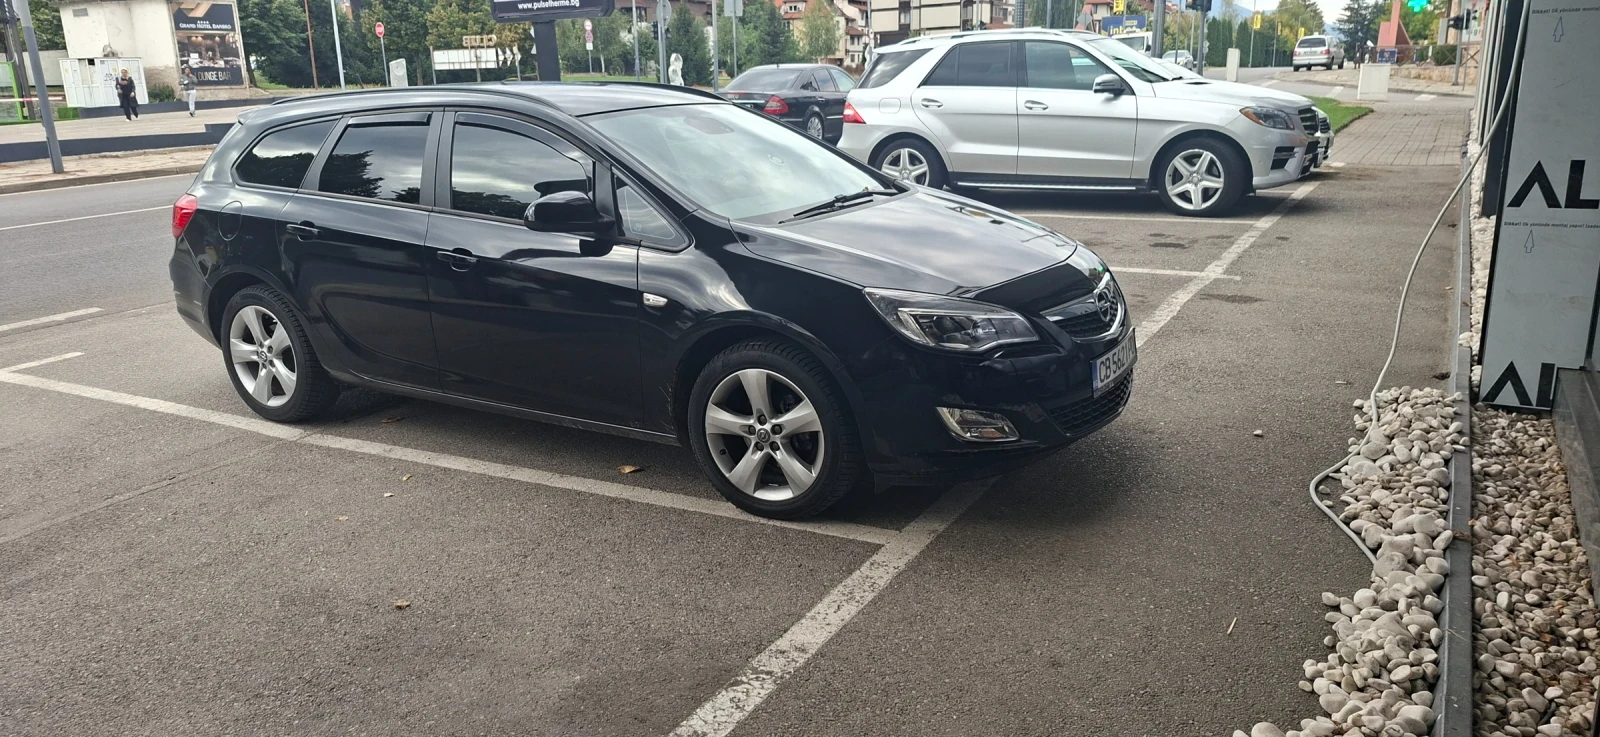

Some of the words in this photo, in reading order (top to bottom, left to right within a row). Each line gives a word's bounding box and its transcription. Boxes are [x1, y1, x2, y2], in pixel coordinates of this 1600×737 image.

[517, 0, 580, 10] www.pulsetherme.bg
[218, 71, 231, 80] BAR
[1506, 159, 1600, 209] AL
[1099, 357, 1112, 384] CB
